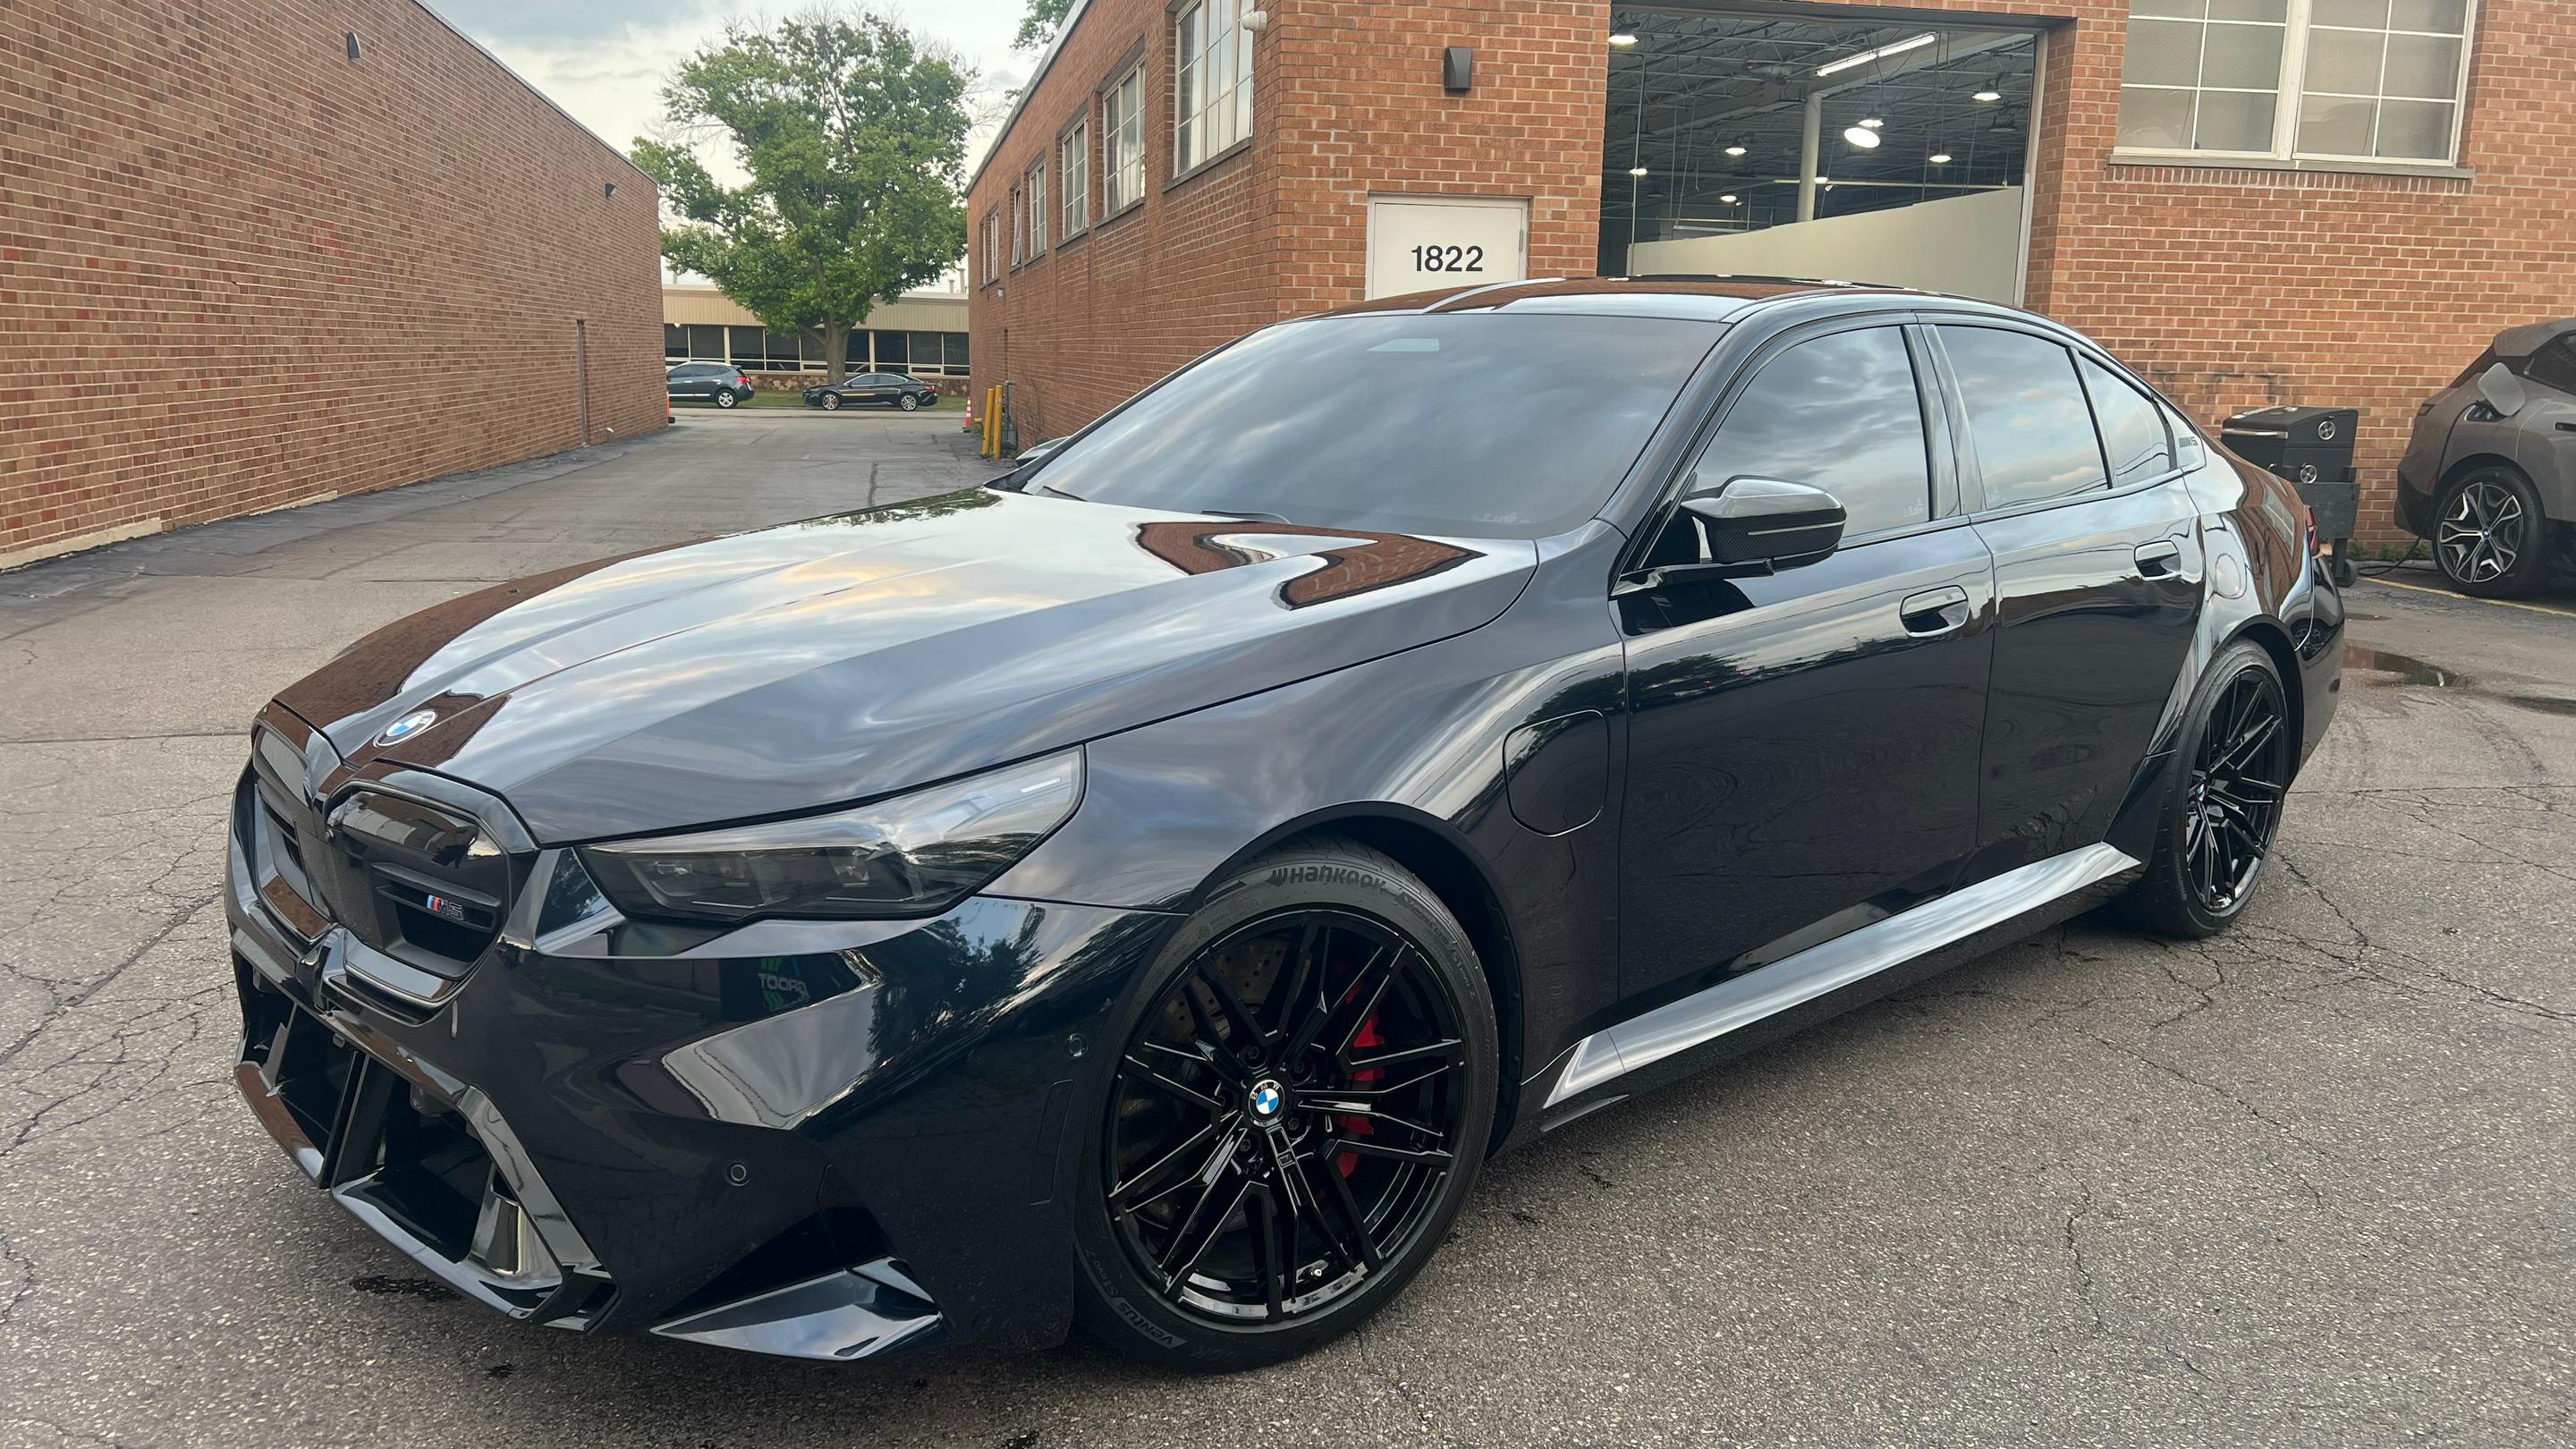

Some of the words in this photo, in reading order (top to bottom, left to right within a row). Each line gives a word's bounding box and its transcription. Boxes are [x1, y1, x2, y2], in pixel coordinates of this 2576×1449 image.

[1411, 245, 1484, 272] 1822
[1291, 865, 1389, 894] Hankook
[436, 897, 464, 921] M5
[1250, 1081, 1281, 1100] BMW
